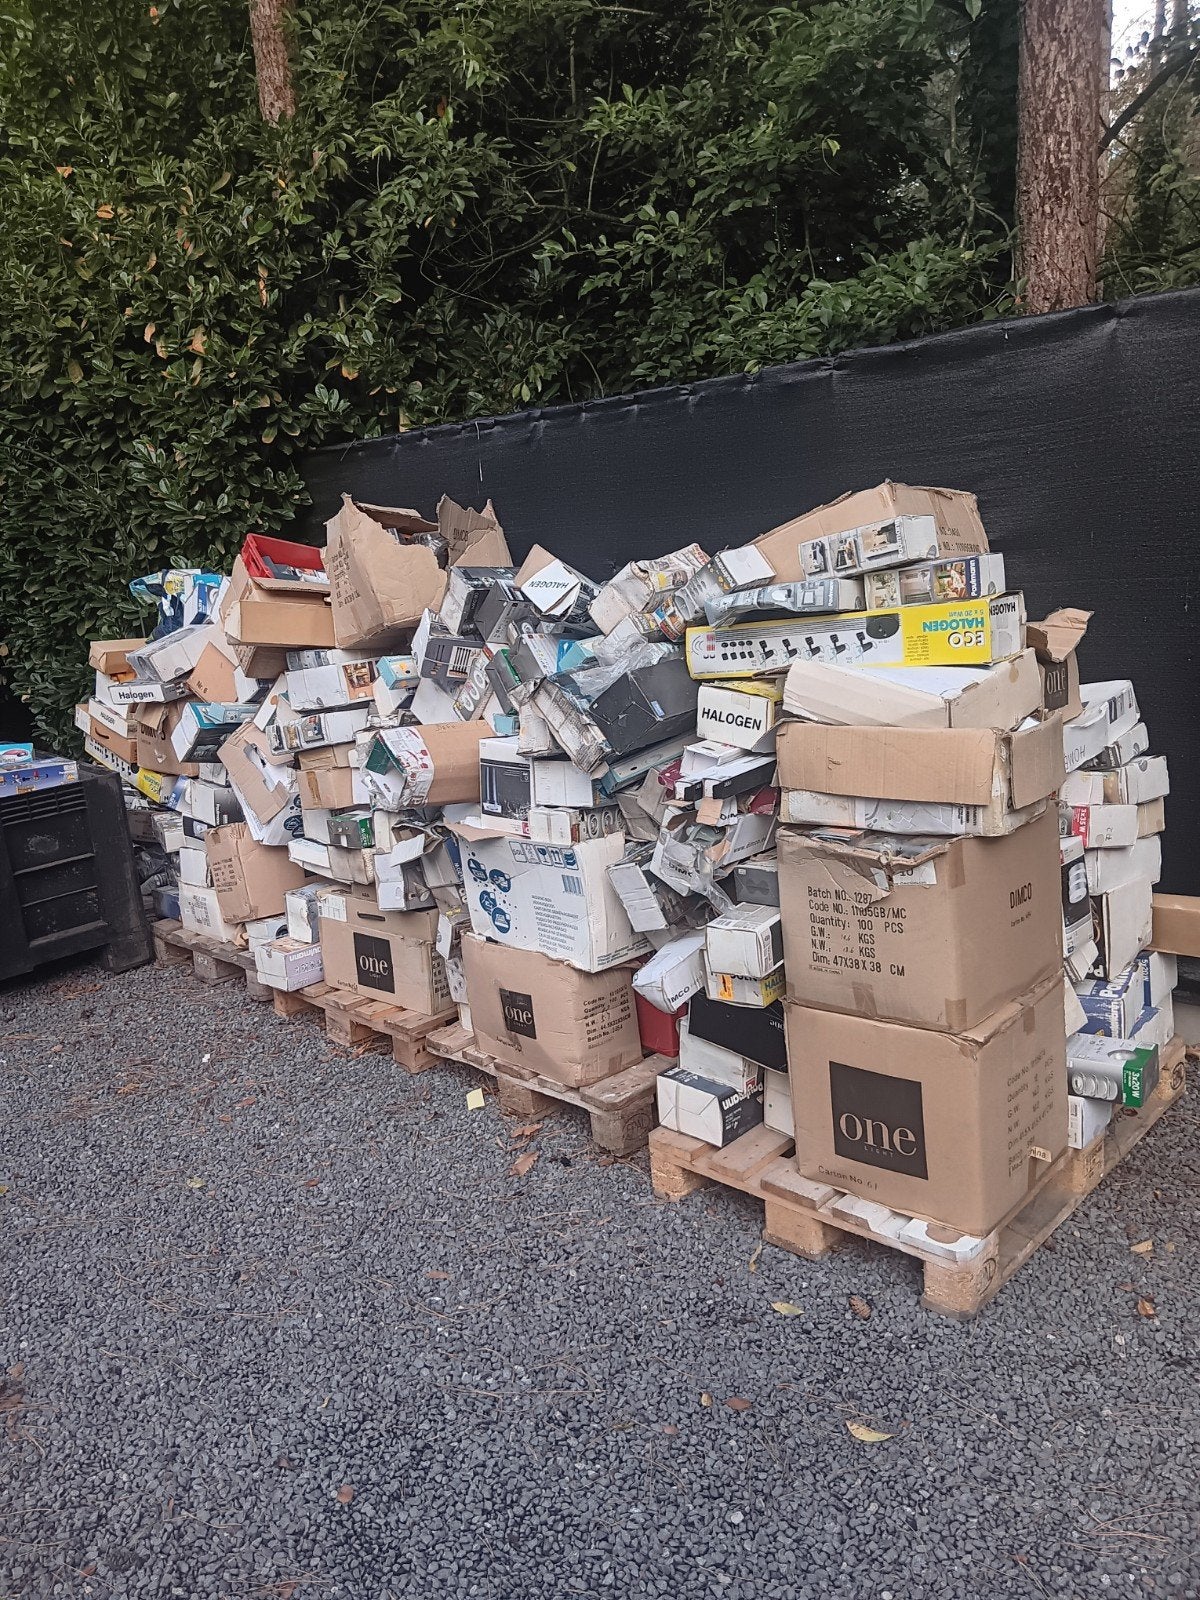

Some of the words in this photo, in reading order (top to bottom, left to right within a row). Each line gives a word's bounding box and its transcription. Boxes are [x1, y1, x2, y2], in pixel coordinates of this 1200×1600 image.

[528, 580, 570, 589] HALOGEN
[990, 601, 1016, 616] HALOGEN
[922, 616, 985, 632] HALOGEN
[948, 631, 985, 648] ECO
[118, 690, 154, 700] Halogen
[702, 707, 762, 731] HALOGEN
[807, 886, 832, 900] Batch
[854, 891, 872, 904] 1287
[1010, 882, 1032, 909] DIMCO
[809, 899, 830, 912] Code
[810, 913, 850, 931] Quantity:
[857, 919, 873, 931] 100
[884, 922, 904, 934] PCS
[858, 933, 875, 945] KGS
[859, 946, 876, 959] KGS
[360, 954, 389, 976] one
[812, 951, 831, 965] Dim:
[890, 964, 905, 977] CM
[505, 1005, 533, 1025] one
[1131, 1071, 1140, 1099] 3x20W
[839, 1112, 917, 1156] one
[864, 1145, 894, 1158] LIGHT
[818, 1164, 848, 1181] Carton
